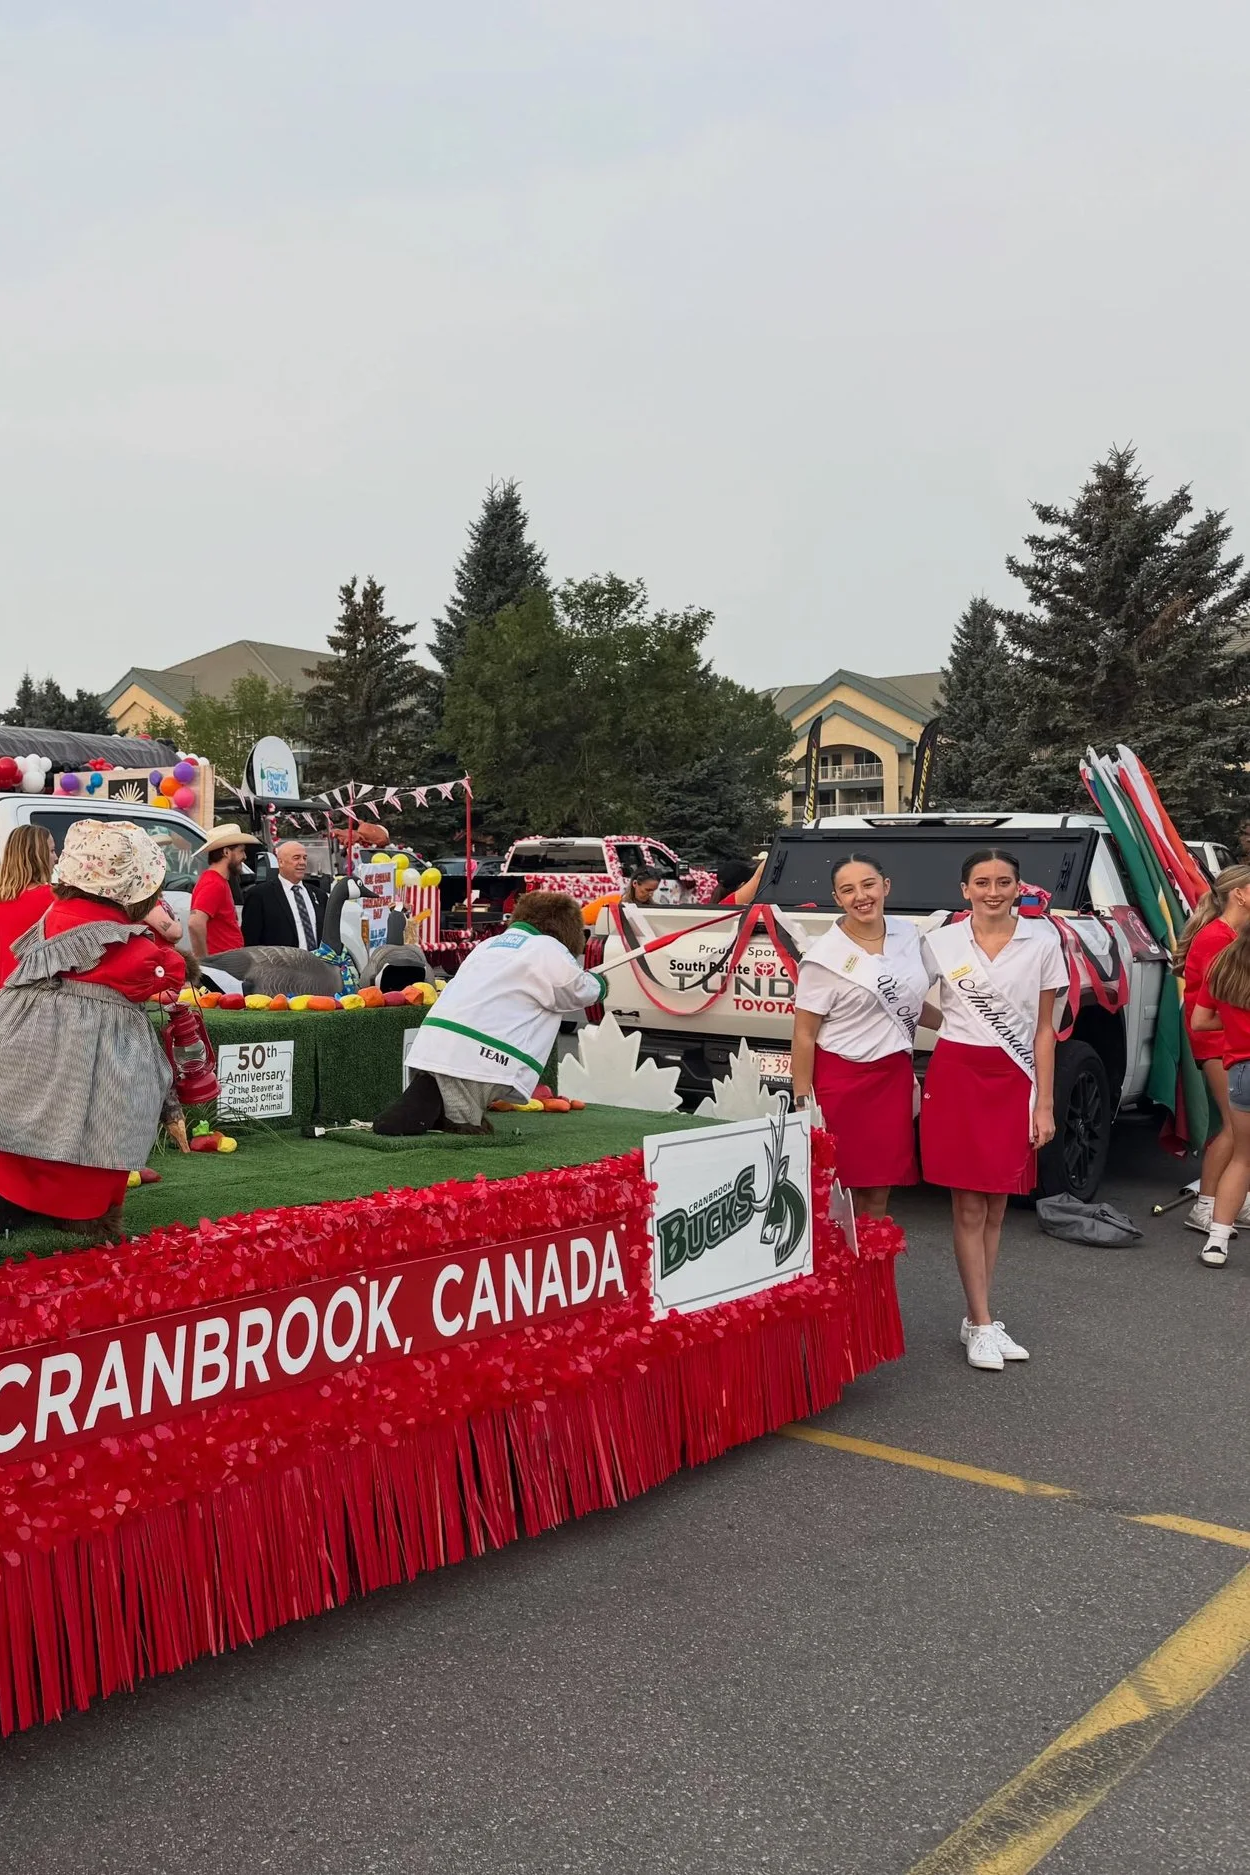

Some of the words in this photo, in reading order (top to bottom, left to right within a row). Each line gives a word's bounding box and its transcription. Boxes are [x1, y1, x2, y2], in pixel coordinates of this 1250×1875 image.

[669, 959, 706, 972] South
[877, 974, 900, 1004] Vice
[733, 998, 796, 1015] TOYOTA
[237, 1044, 277, 1071] 50th
[480, 1045, 510, 1067] TEAM
[226, 1069, 286, 1084] Anniversary
[228, 1086, 236, 1095] of
[238, 1085, 249, 1094] the
[251, 1084, 275, 1093] Beaver
[227, 1094, 259, 1105] Canada's
[260, 1092, 284, 1102] Official
[259, 1101, 283, 1112] Animal
[688, 1180, 734, 1214] CRANBROOK
[431, 1228, 628, 1338] CANADA
